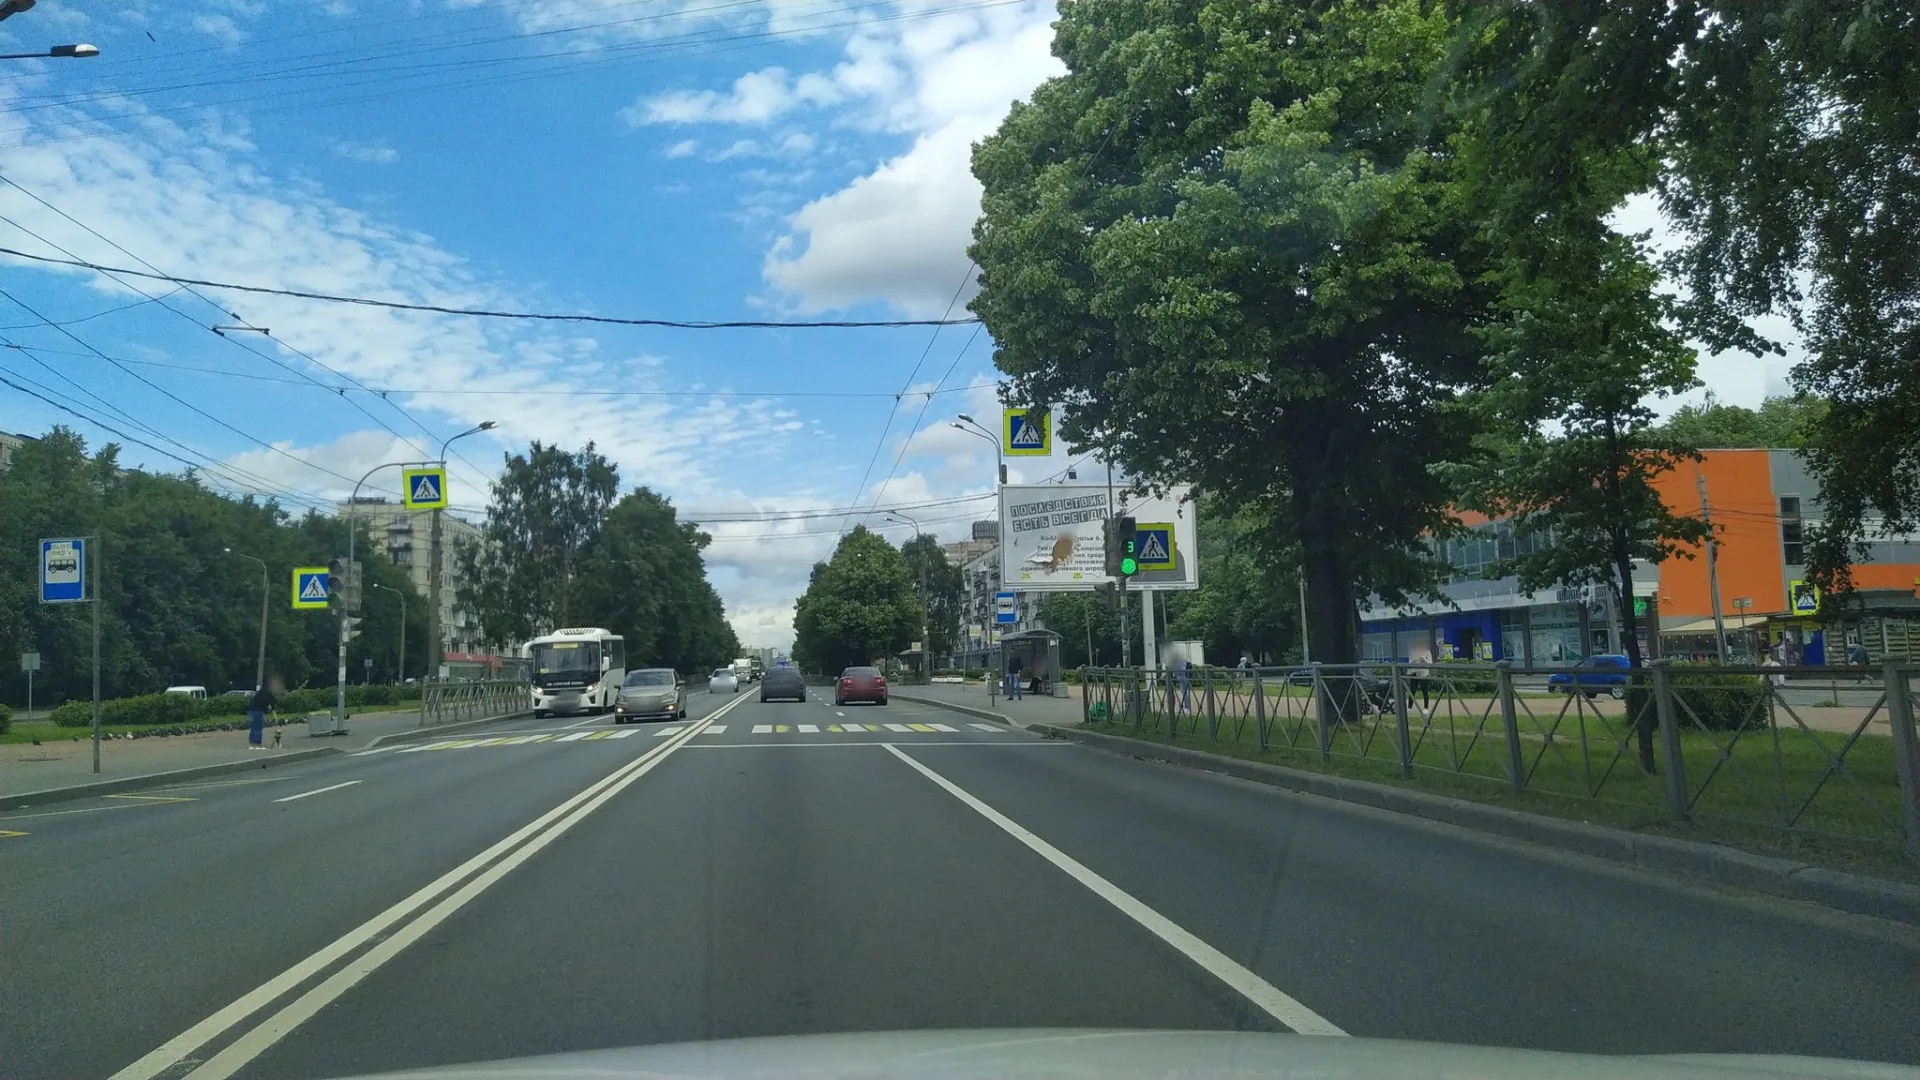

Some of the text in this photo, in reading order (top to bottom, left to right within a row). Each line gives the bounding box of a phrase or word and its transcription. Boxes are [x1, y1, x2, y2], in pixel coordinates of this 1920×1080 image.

[1011, 494, 1106, 517] ПОСЛЕДСТВИЯ
[1013, 508, 1108, 532] ЕСТЬ ВСЕГДА
[1127, 541, 1134, 553] 3
